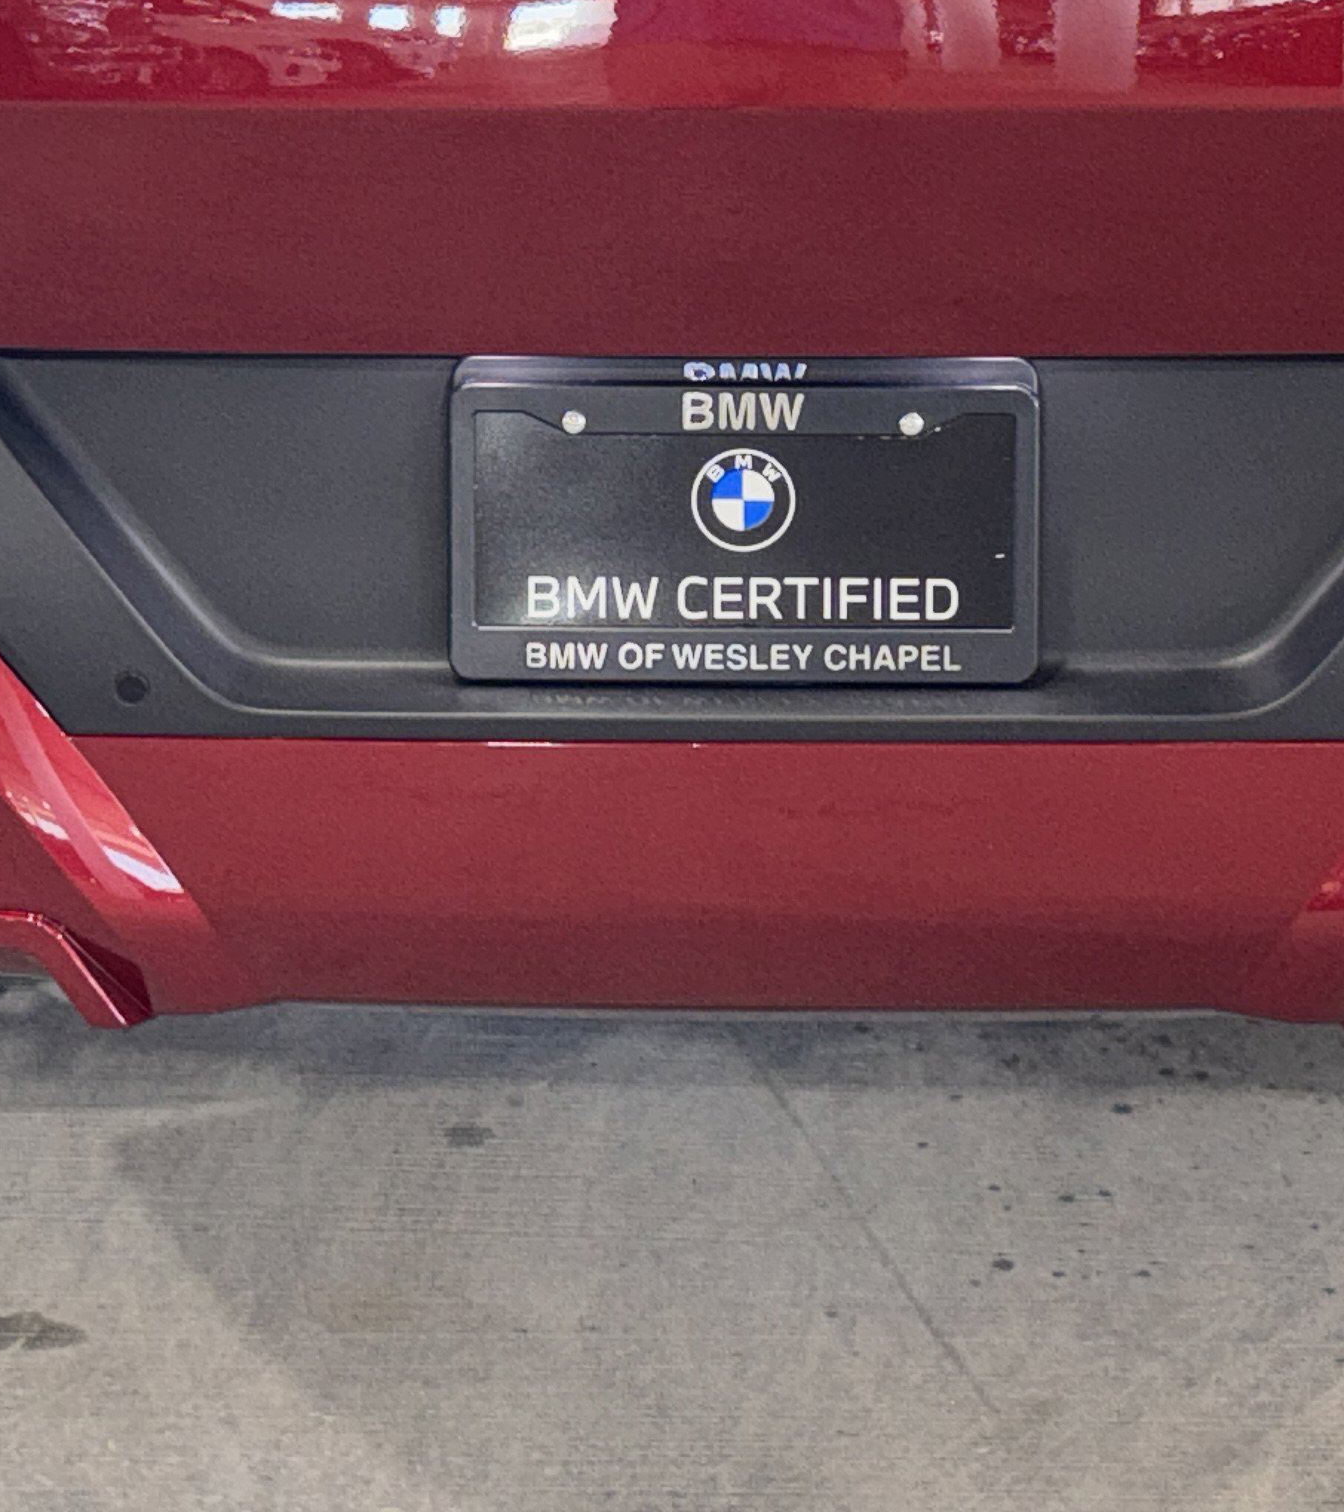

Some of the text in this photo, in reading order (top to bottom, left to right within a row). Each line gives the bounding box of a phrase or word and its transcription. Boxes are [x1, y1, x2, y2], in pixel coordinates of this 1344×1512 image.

[682, 391, 805, 431] BMW
[706, 453, 782, 483] BMW
[526, 575, 960, 621] BMW CERTIFIED
[525, 641, 962, 672] BMW OF WESLEY CHAPEL
